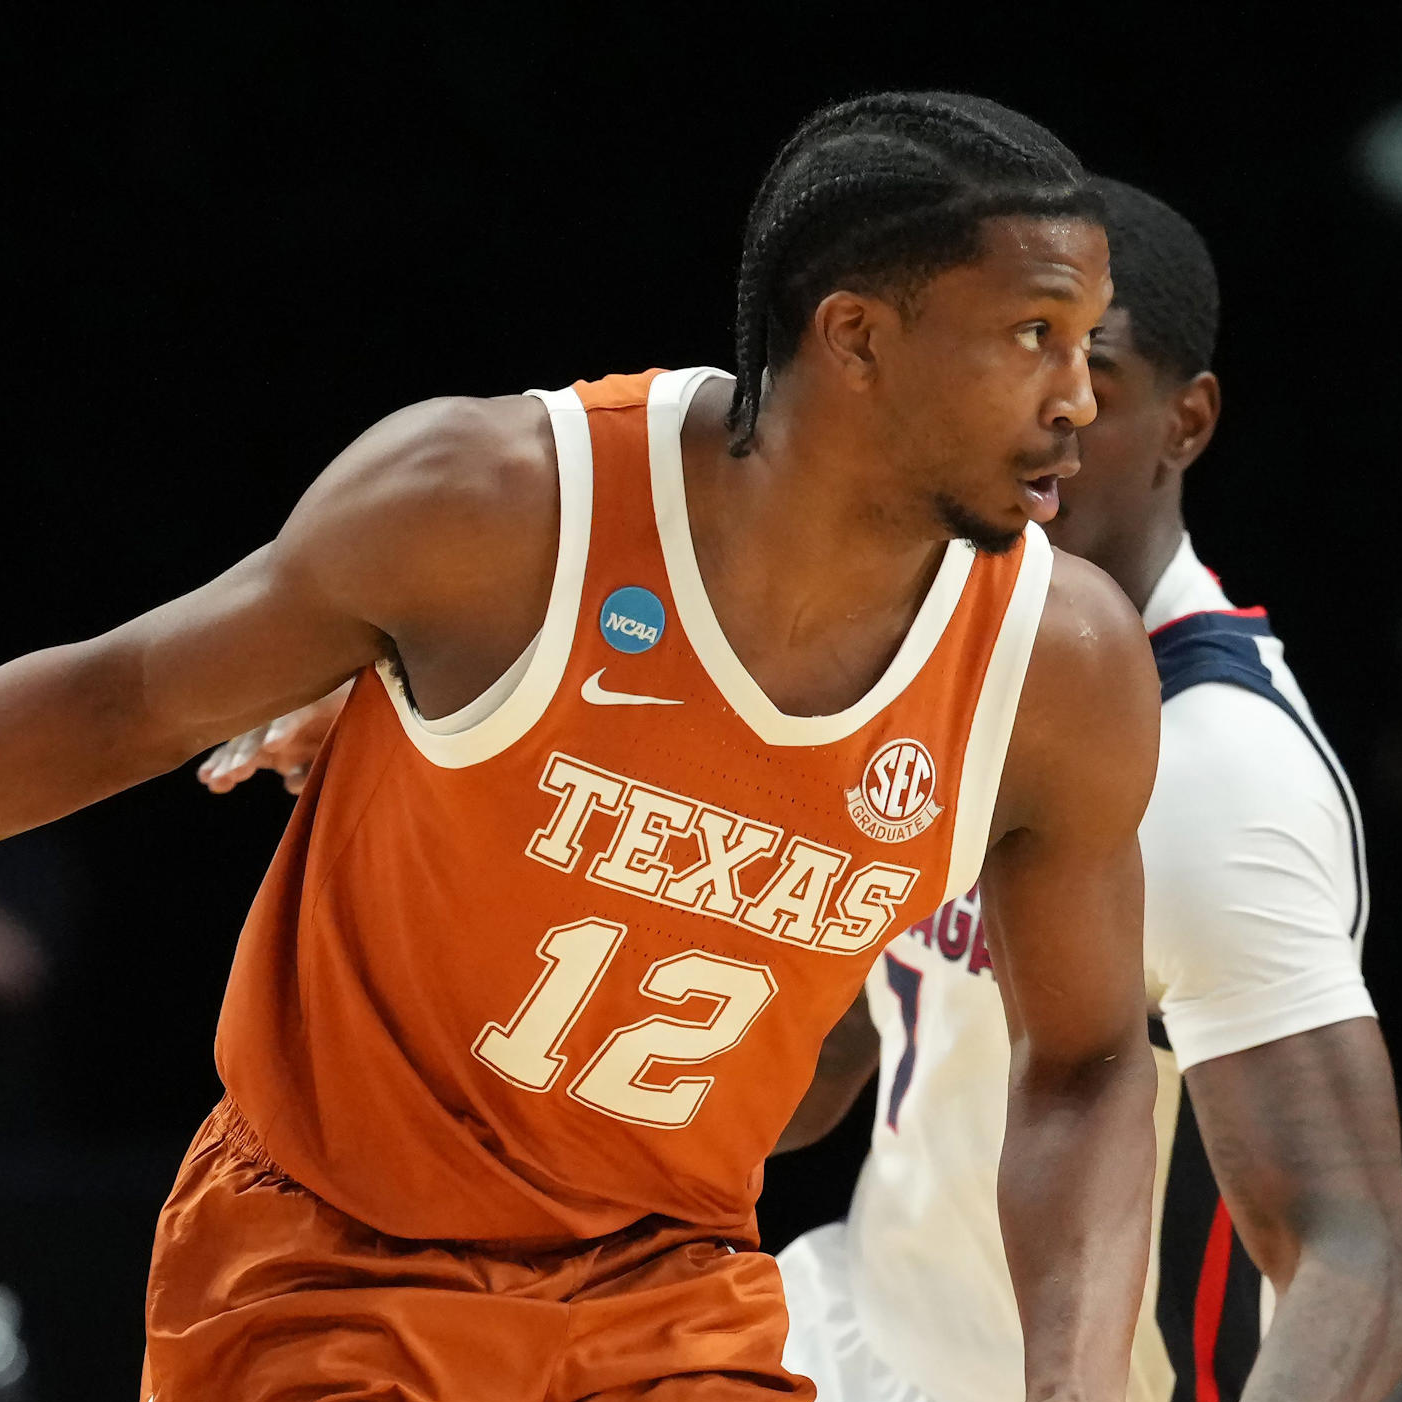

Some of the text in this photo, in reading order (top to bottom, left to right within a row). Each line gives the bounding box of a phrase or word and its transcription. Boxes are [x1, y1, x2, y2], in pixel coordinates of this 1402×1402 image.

[605, 611, 657, 644] NCAA
[869, 744, 931, 818] SEC
[525, 751, 920, 955] TEXAS
[851, 804, 926, 842] GRADUATE
[471, 917, 779, 1130] 12
